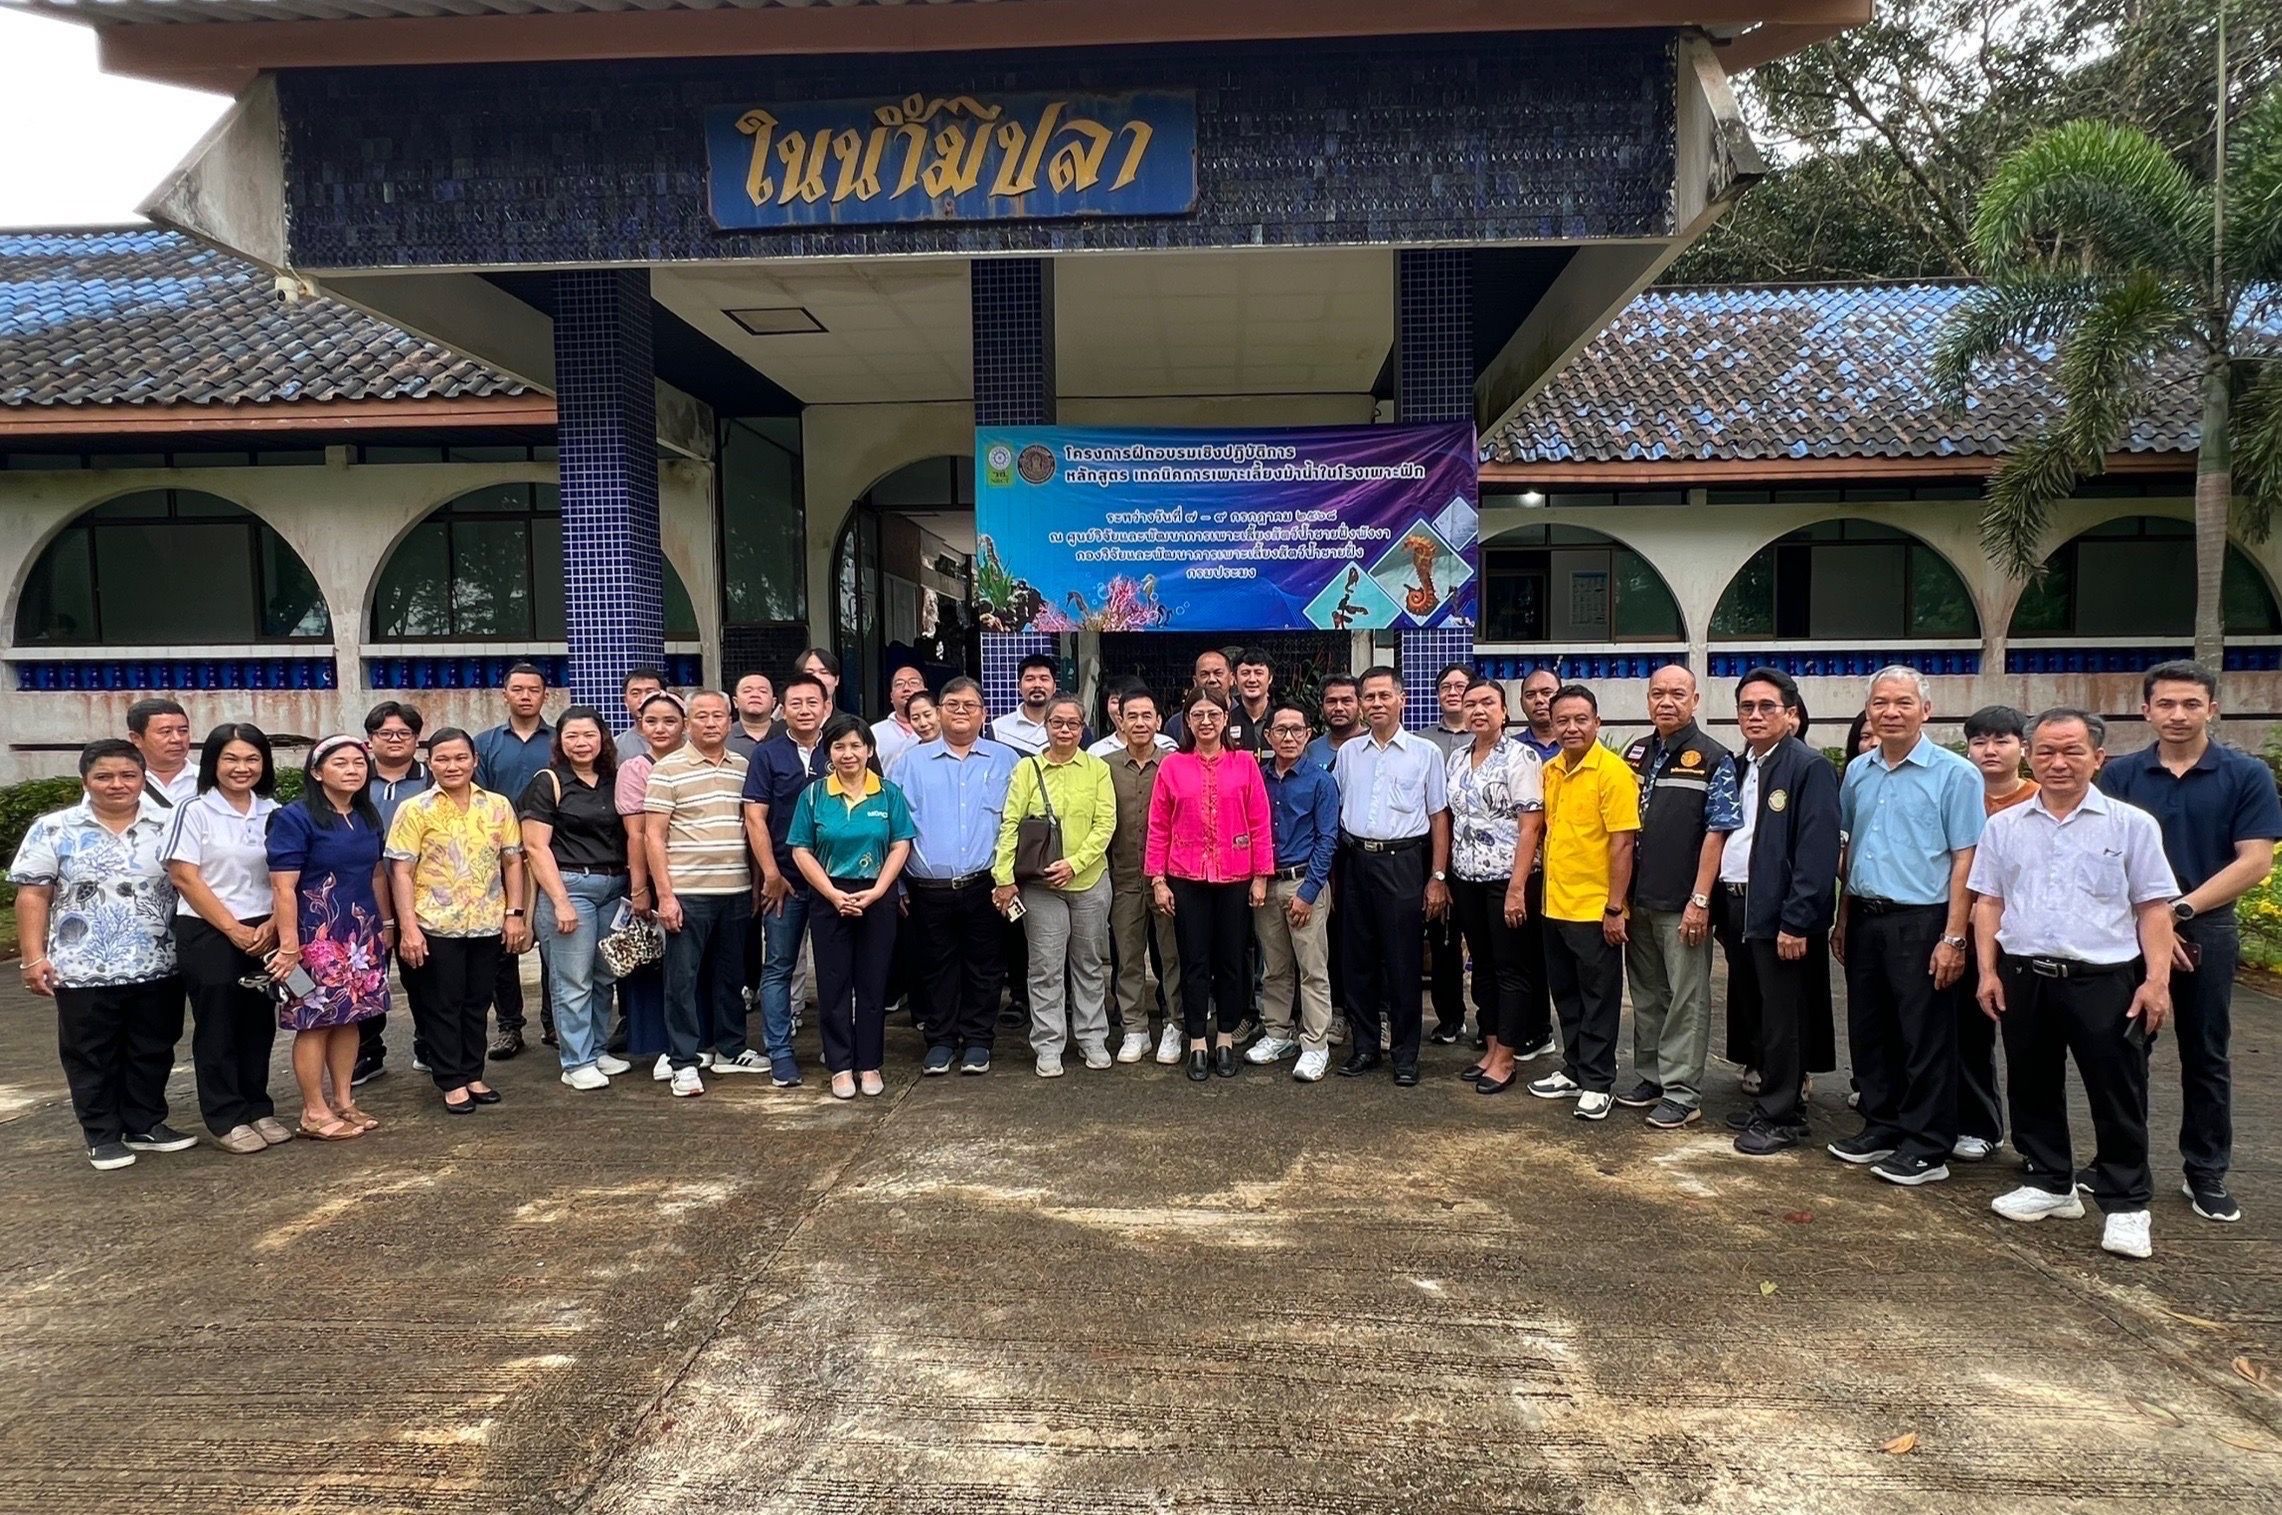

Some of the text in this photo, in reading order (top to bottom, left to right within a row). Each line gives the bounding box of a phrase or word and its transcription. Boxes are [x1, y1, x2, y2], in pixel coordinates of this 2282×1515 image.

[734, 93, 1154, 207] ในน้ำมีปลา
[1064, 444, 1296, 463] โครงการฝึกอบรมเชิงปฏิบัติการ
[1065, 459, 1426, 487] หลักสูตร เทคนิคการเพาะเลี้ยงม้าน้ำในโรงเพาะฟัก
[1106, 505, 1182, 524] ระหว่างวันที่
[1230, 510, 1292, 525] กรกฎาคม
[1295, 509, 1337, 521] ๒๕๖๘
[1049, 522, 1391, 546] ณ ศูนย์วิจัยและพัฒนาการเพาะเลี้ยงสัตว์น้ำชายฝั่งพังงา
[1076, 541, 1364, 561] กองวิจัยและพัฒนาการเพาะเลี้ยงสัตว์น้ำชายฝั่ง
[1186, 565, 1256, 579] กรมประมง
